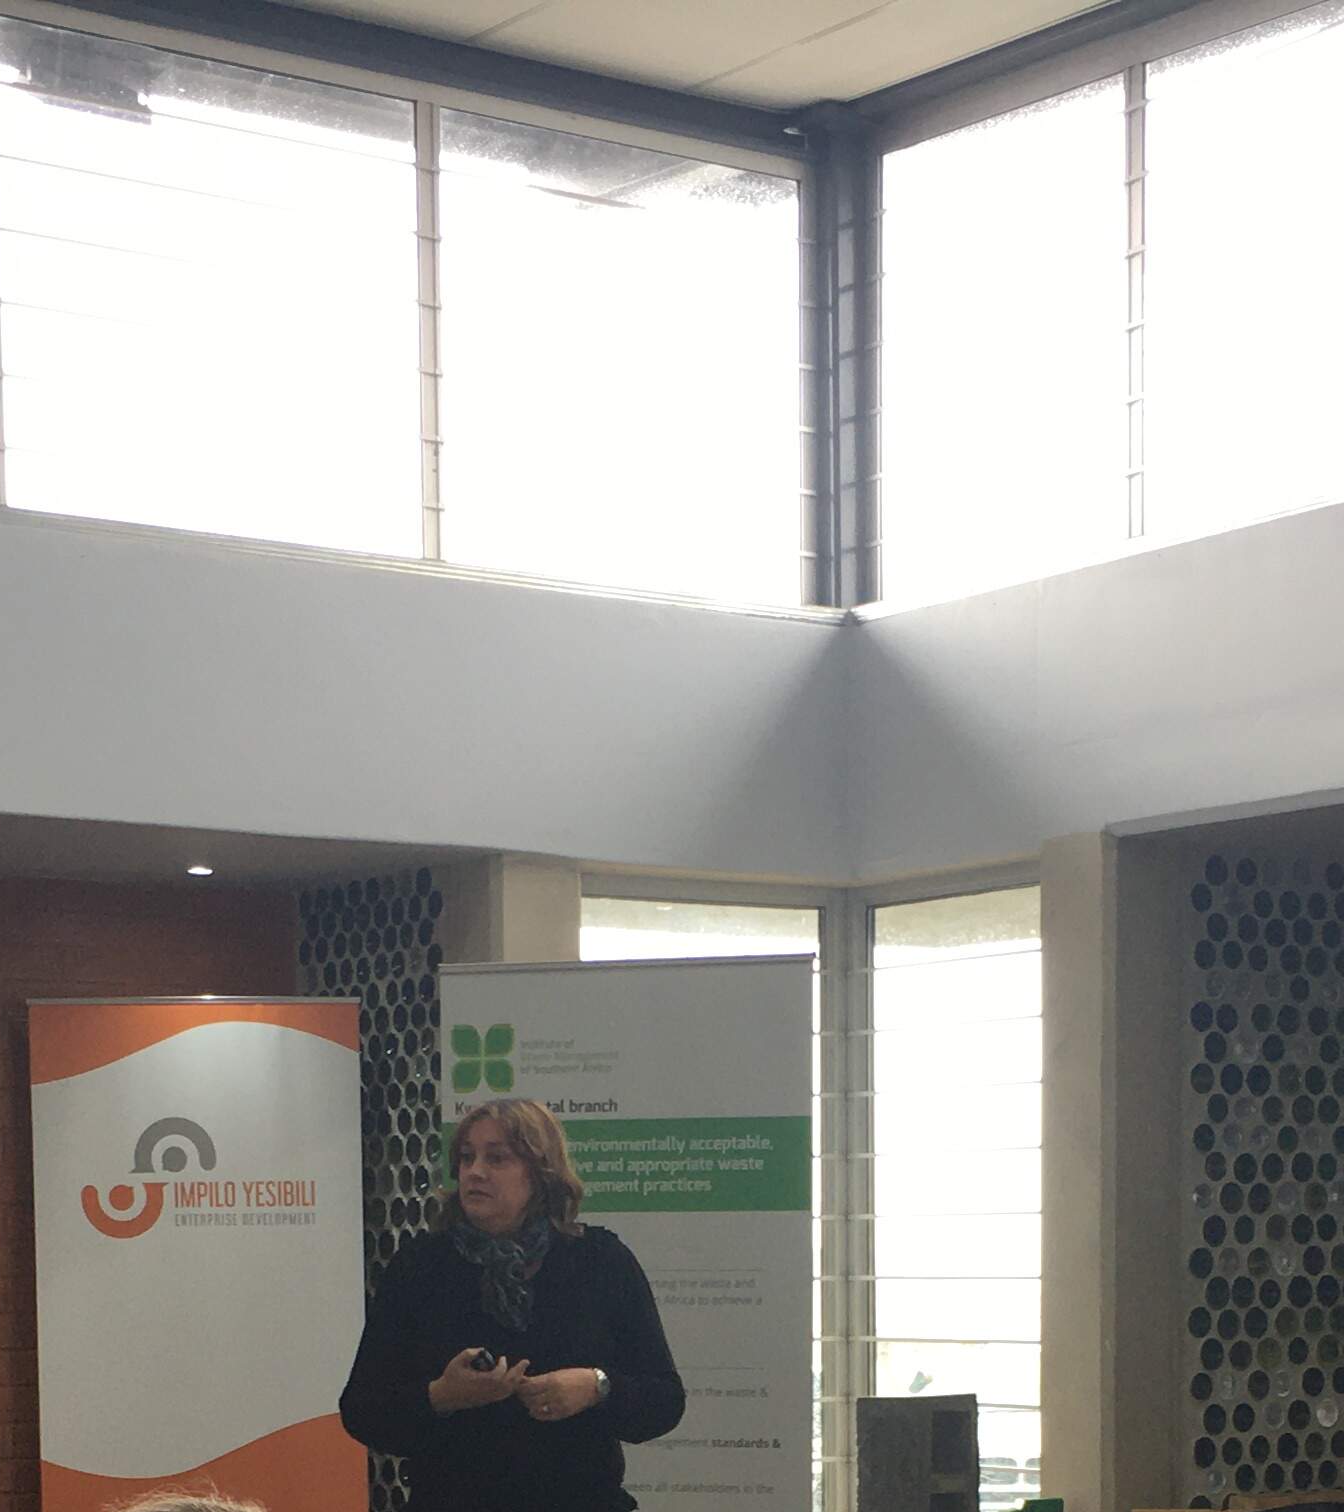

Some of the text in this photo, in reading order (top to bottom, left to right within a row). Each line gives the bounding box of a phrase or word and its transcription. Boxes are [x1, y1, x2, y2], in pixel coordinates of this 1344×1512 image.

[569, 1098, 618, 1114] branch
[689, 1135, 774, 1153] acceptable,
[596, 1157, 625, 1172] and
[627, 1157, 715, 1175] appropriate
[718, 1157, 765, 1171] waste
[174, 1180, 316, 1208] IMPILO YESIBILI
[643, 1178, 713, 1195] practices
[175, 1212, 317, 1227] ENTERPRISE DEVELOPMENT
[711, 1437, 770, 1448] standards
[772, 1437, 782, 1448] &
